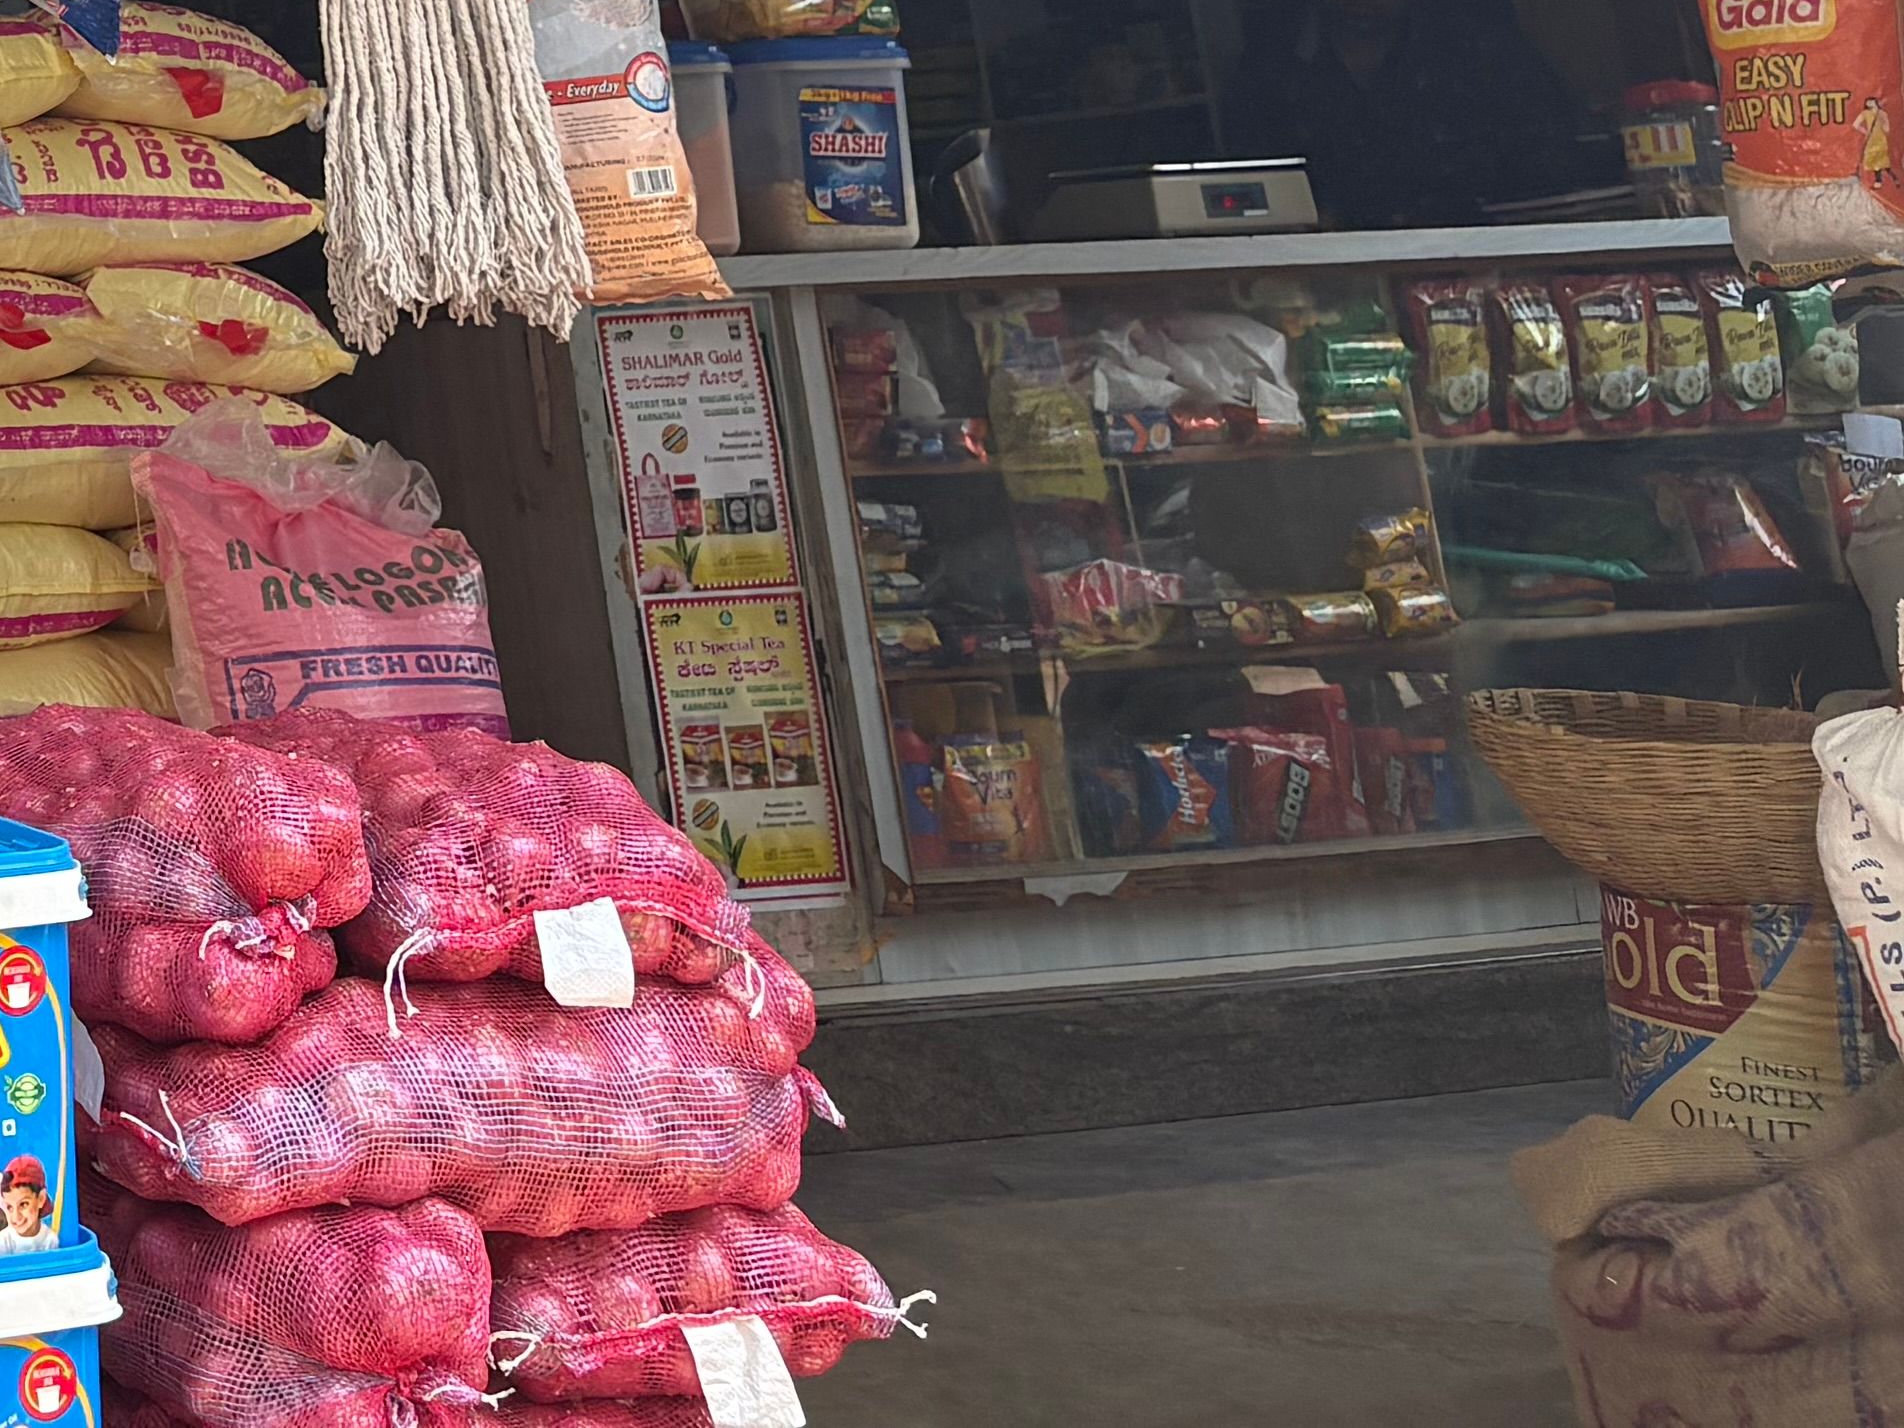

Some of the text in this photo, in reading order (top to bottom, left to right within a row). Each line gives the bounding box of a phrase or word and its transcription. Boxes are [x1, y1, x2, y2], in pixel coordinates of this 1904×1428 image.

[1734, 53, 1806, 93] EASY
[565, 77, 620, 101] Everyday
[1723, 90, 1851, 133] CLIP N FIT
[810, 132, 886, 155] SHASHI
[621, 349, 743, 372] SHALIMAR Gold
[673, 636, 786, 658] KT Special Tea
[301, 654, 408, 680] FRESH
[1609, 915, 1726, 1008] old
[1740, 1055, 1822, 1081] FINEST
[1709, 1076, 1825, 1112] SORTEX
